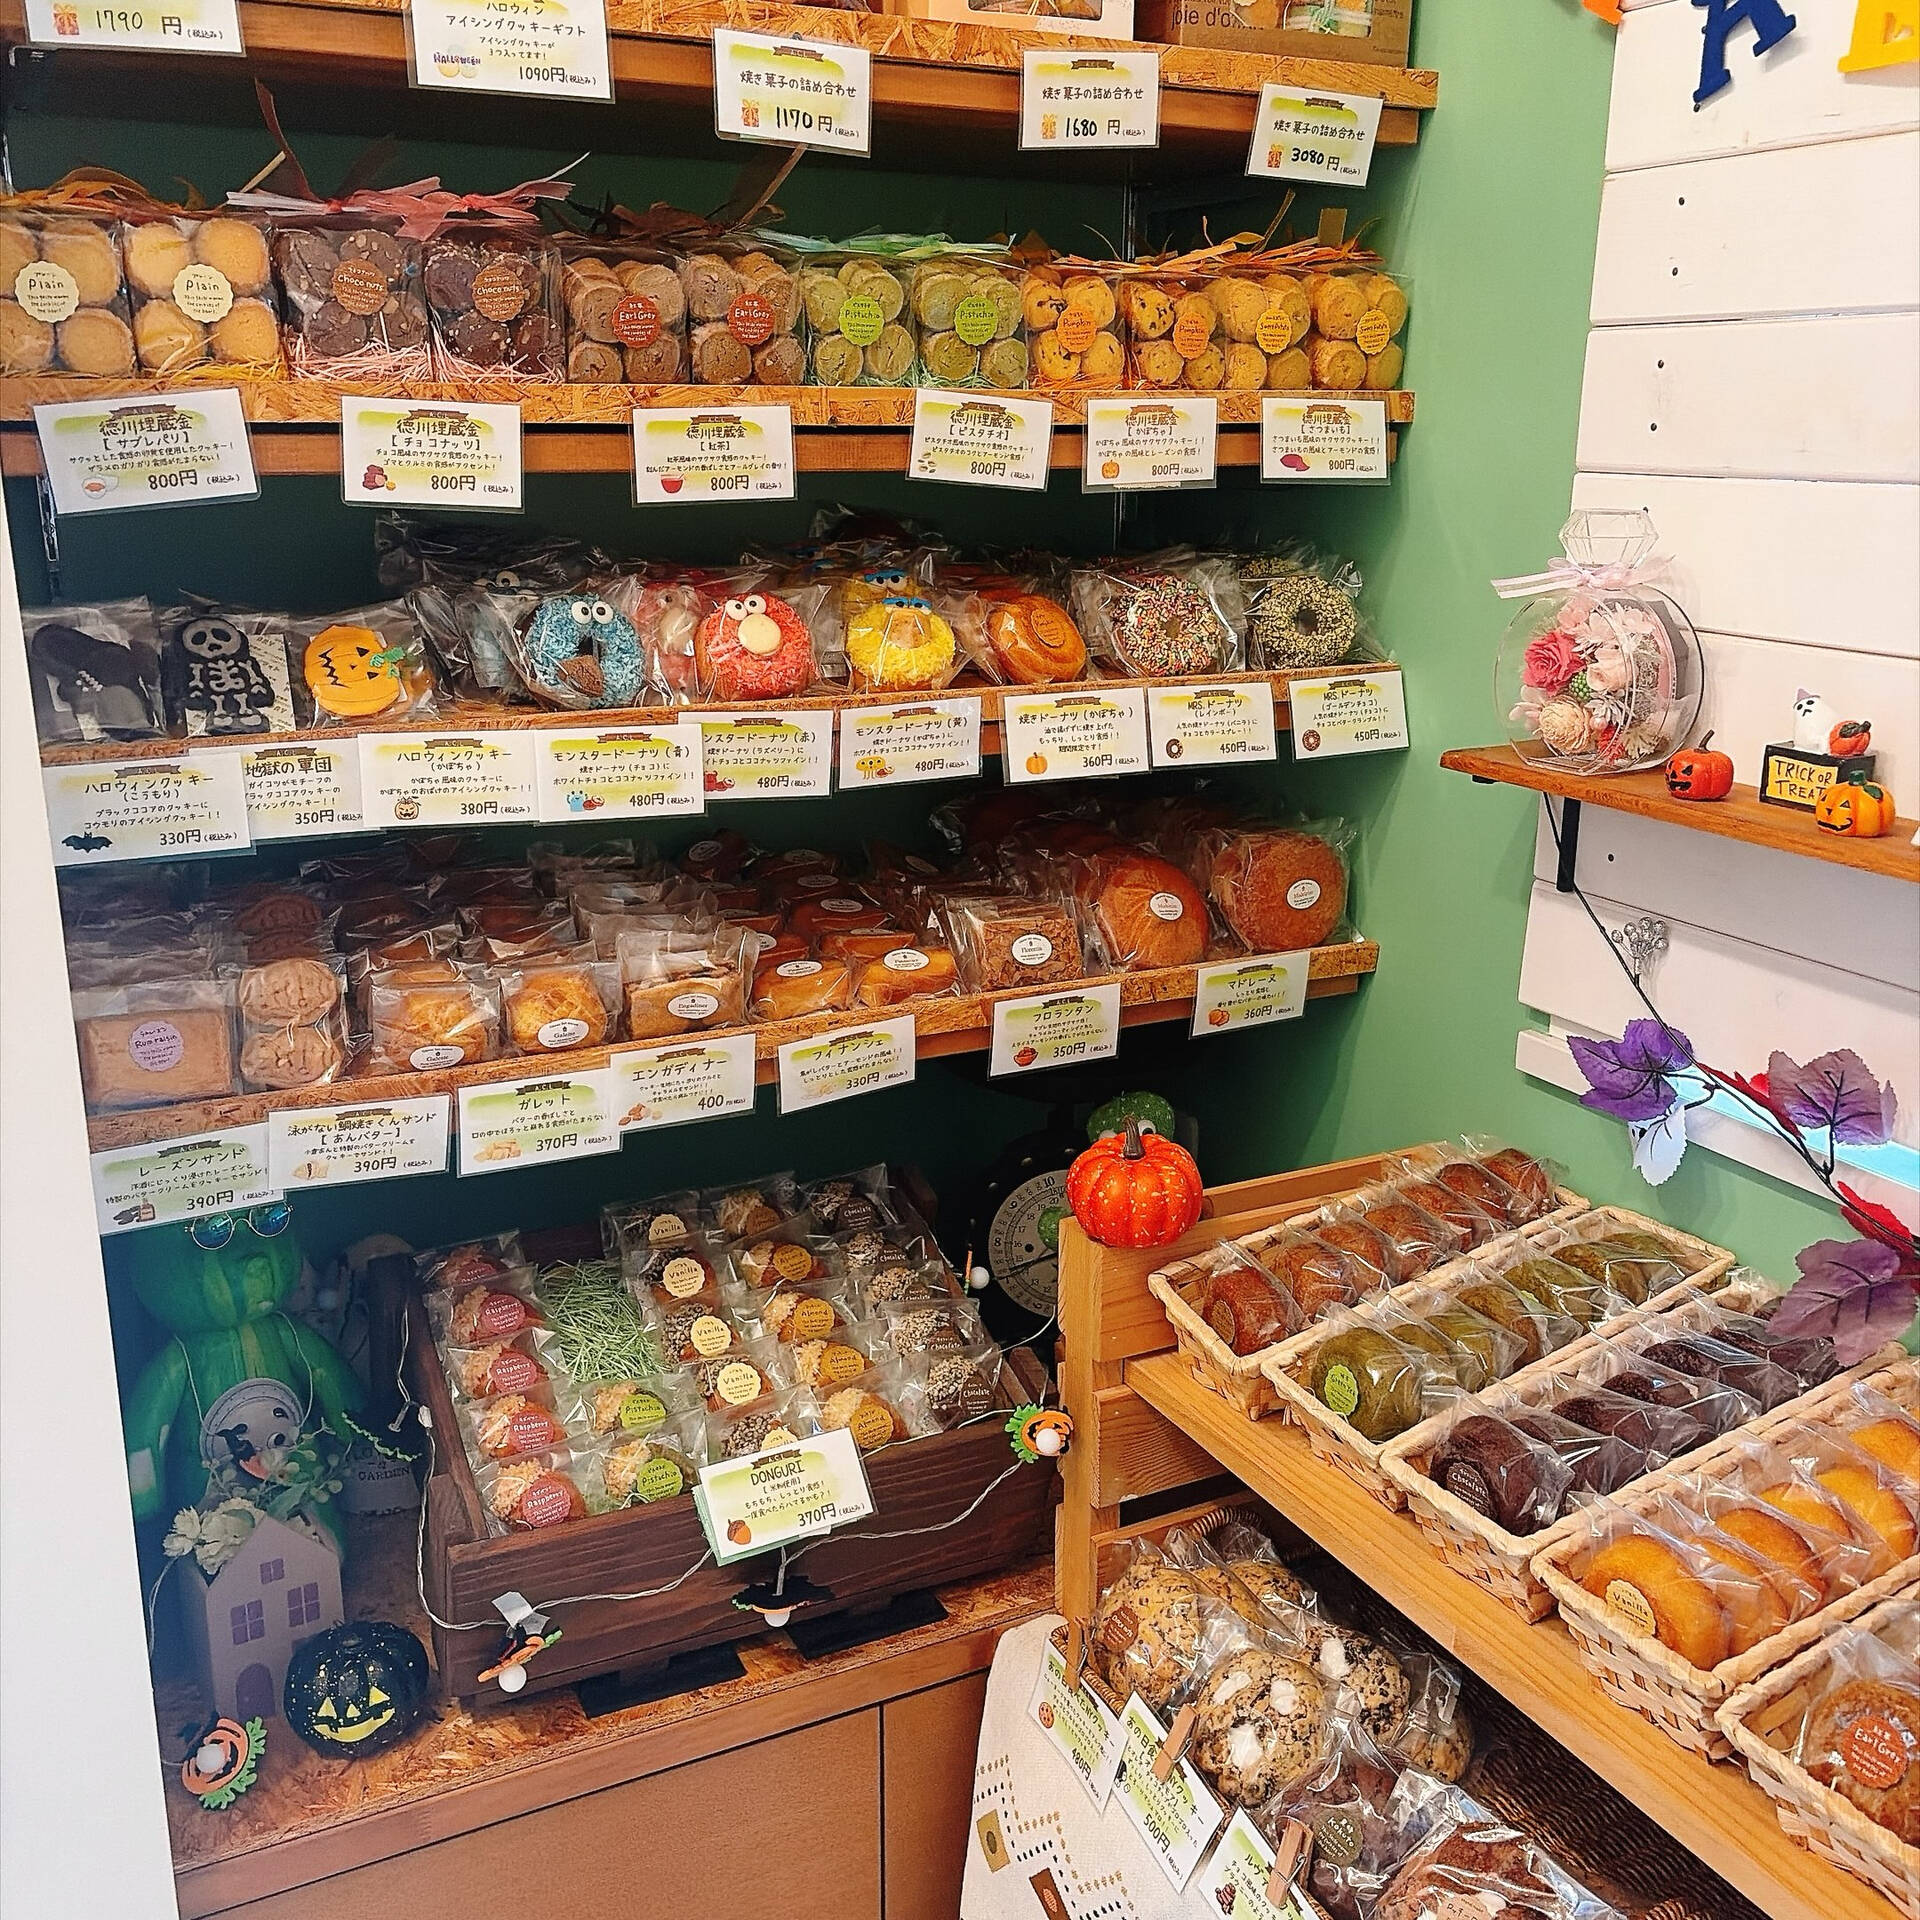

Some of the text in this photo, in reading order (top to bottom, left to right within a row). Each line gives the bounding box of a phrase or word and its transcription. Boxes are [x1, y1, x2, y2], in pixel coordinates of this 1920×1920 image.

[486, 1, 544, 16] ハロウィン
[96, 10, 143, 32] 1790
[161, 16, 182, 36] 円
[446, 15, 586, 37] アイシングクッキーギフト
[519, 66, 565, 83] 1090円
[740, 70, 857, 98] 焼き菓子の詰め合わせ
[1042, 87, 1144, 100] 焼き菓子の詰め合わせ
[776, 106, 832, 133] 1170 円
[1066, 118, 1120, 138] 1680 円
[1273, 120, 1366, 141] 焼き菓子の詰め合わせ
[1291, 148, 1340, 171] 3080 円
[29, 278, 64, 289] Plain
[186, 280, 219, 291] Plain
[338, 274, 365, 287] Choco
[99, 413, 193, 436] 徳川埋蔵金
[950, 410, 1016, 430] 徳川埋蔵金
[1125, 413, 1180, 427] 徳川埋蔵金
[1302, 412, 1352, 425] 徳川埋蔵金
[396, 419, 481, 438] 徳川埋蔵金
[686, 426, 747, 440] 徳川埋蔵金
[949, 425, 1009, 440] 【ピスタチオ】
[1128, 426, 1173, 436] 【かぼちゃ】
[1301, 425, 1351, 435] 【さつまいも】
[391, 435, 481, 450] 【チョコナッツ】
[700, 441, 730, 451] 【紅茶】
[970, 461, 1006, 477] 800円
[1151, 463, 1180, 476] 800円
[1328, 459, 1355, 471] 800円
[149, 469, 197, 490] 800円
[431, 475, 476, 491] 800円
[711, 475, 749, 491] 800円
[1018, 707, 1134, 725] 焼きドーナツ（かぼちゃ）
[855, 717, 968, 737] モンスタードーナツ（黄）
[704, 732, 816, 743] ンスタードーナツ（赤）
[1354, 728, 1380, 742] 450円
[554, 746, 690, 762] モンスタードーナツ（青）
[1220, 741, 1246, 754] 450円
[397, 749, 512, 762] ハロウィンクッキー
[1082, 753, 1113, 768] 360円
[245, 756, 332, 778] 地獄の軍団
[431, 762, 481, 771] （かぼちゃ）
[914, 759, 945, 772] 480円
[1775, 759, 1815, 782] TRICK
[84, 774, 214, 794] ハロウィンクッキー
[249, 776, 332, 789] ガイコツがモチーフの
[757, 775, 789, 788] 480円
[123, 789, 180, 802] （こうもり）
[1775, 780, 1827, 799] TREAT
[629, 793, 665, 807] 480円
[460, 801, 498, 815] 380円
[295, 809, 334, 825] 350円
[159, 829, 201, 846] 330円
[1228, 974, 1277, 990] マドレーヌ
[1033, 1005, 1094, 1022] フロランタン
[1244, 1004, 1272, 1019] 360円
[135, 1039, 153, 1049] Rum
[813, 1039, 884, 1061] フィナンシェ
[1053, 1041, 1086, 1058] 350円
[632, 1059, 727, 1082] エンガディナー
[846, 1072, 880, 1090] 330円
[518, 1093, 571, 1111] ガレット
[698, 1095, 724, 1110] 400
[287, 1112, 437, 1137] 泳がない鯛焼きくんサンド
[320, 1127, 401, 1146] 【あんバター】
[536, 1133, 578, 1152] 370円
[139, 1148, 246, 1177] レーズンサンド
[353, 1157, 396, 1173] 390円
[1043, 1176, 1055, 1188] 10
[186, 1190, 234, 1211] 390円
[1009, 1200, 1018, 1210] 9
[654, 1224, 682, 1236] Vanilla
[994, 1238, 1001, 1247] 8
[669, 1266, 699, 1279] Vanilla
[802, 1309, 828, 1317] Almond
[697, 1326, 724, 1337] Vanilla
[496, 1360, 532, 1375] Raspberry
[830, 1356, 857, 1365] Almond
[723, 1374, 754, 1385] Vanilla
[626, 1404, 660, 1413] Pistachio
[514, 1420, 548, 1432] Raspberry
[858, 1416, 886, 1429] Almond
[641, 1471, 678, 1486] Pistachio
[750, 1459, 805, 1486] DONGURI
[527, 1491, 564, 1507] Raspberry
[797, 1502, 837, 1527] 370円
[1613, 1592, 1649, 1617] Vanilla
[1143, 1814, 1171, 1853] 500円
